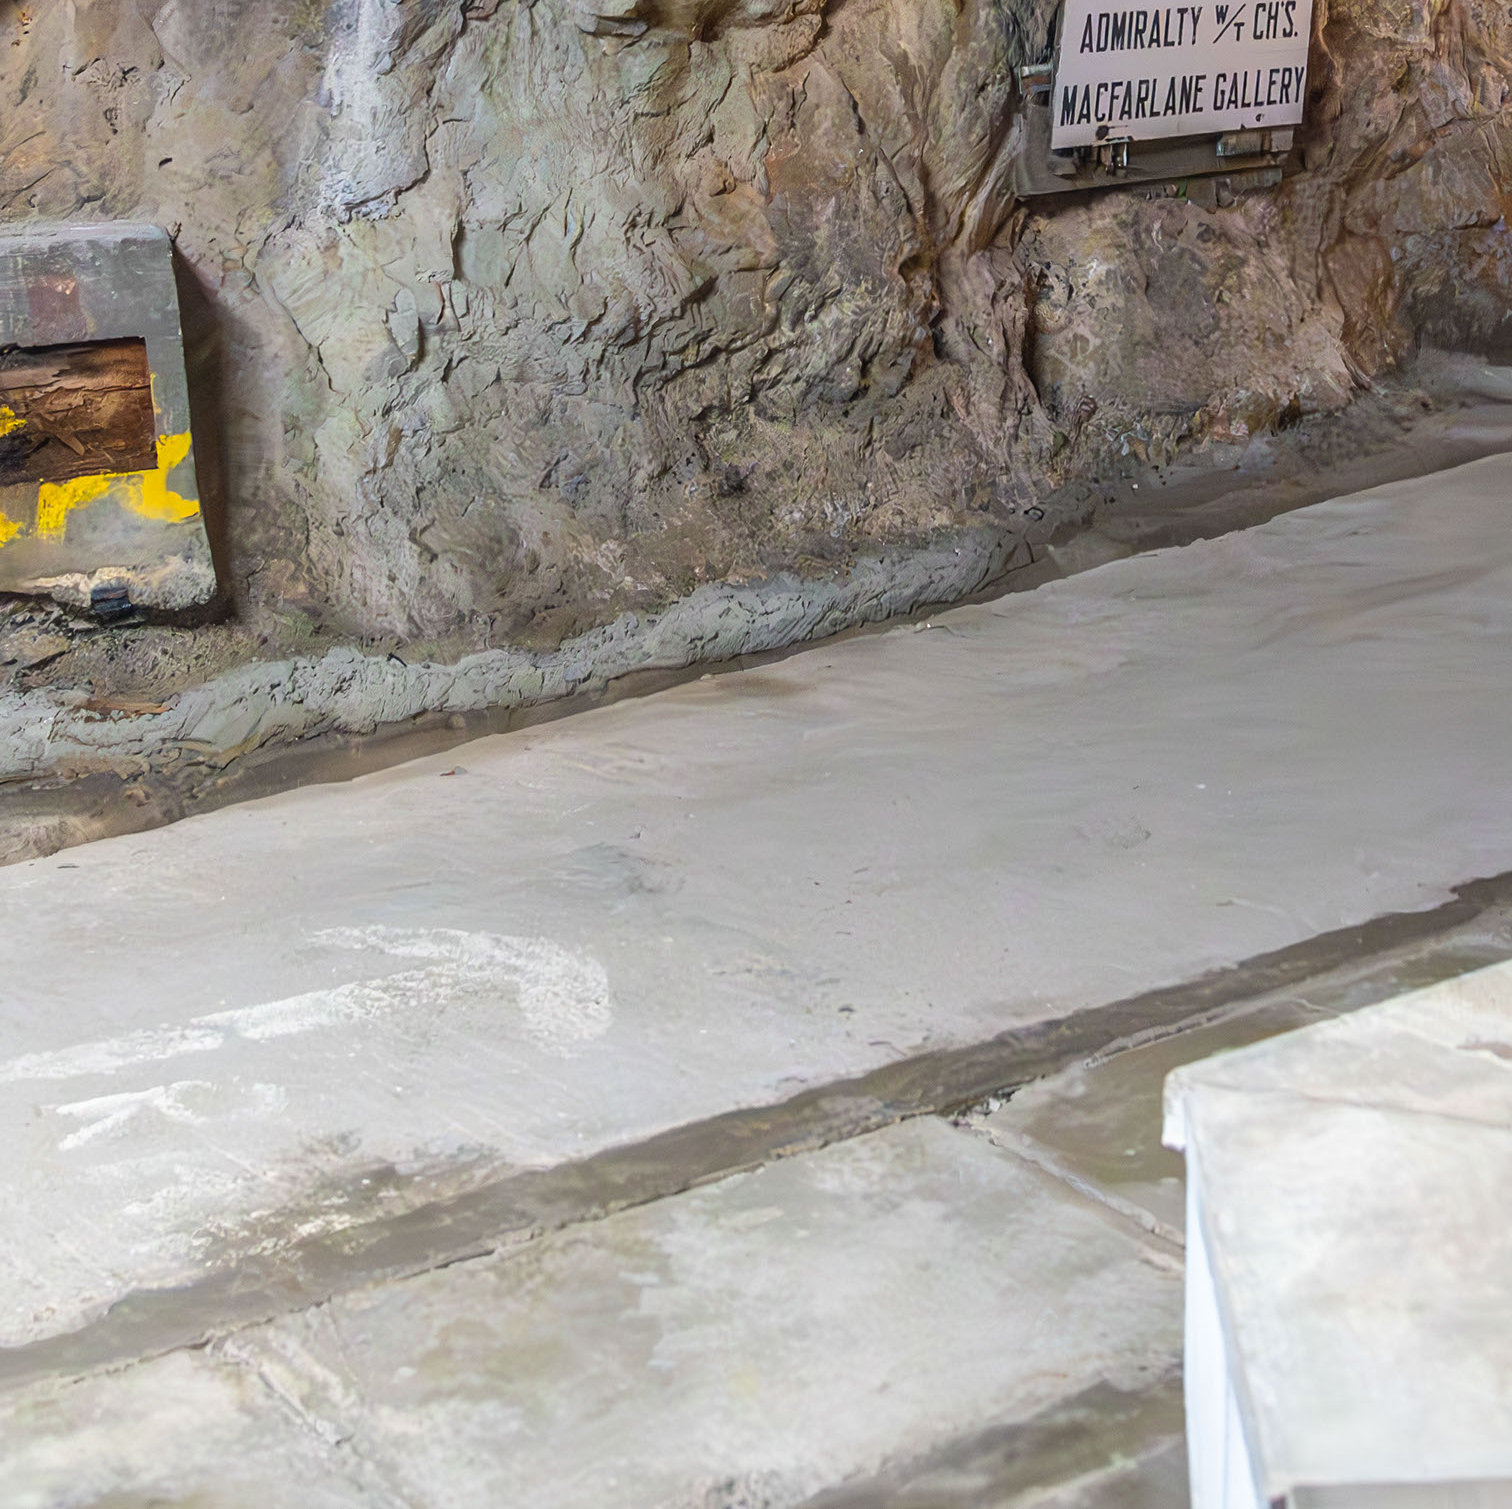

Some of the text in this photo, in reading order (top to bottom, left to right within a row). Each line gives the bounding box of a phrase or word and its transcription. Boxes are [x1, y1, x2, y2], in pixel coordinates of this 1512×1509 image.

[1080, 6, 1203, 53] ADMIRALTY
[1060, 66, 1305, 126] MACFARLANE GALLERY
